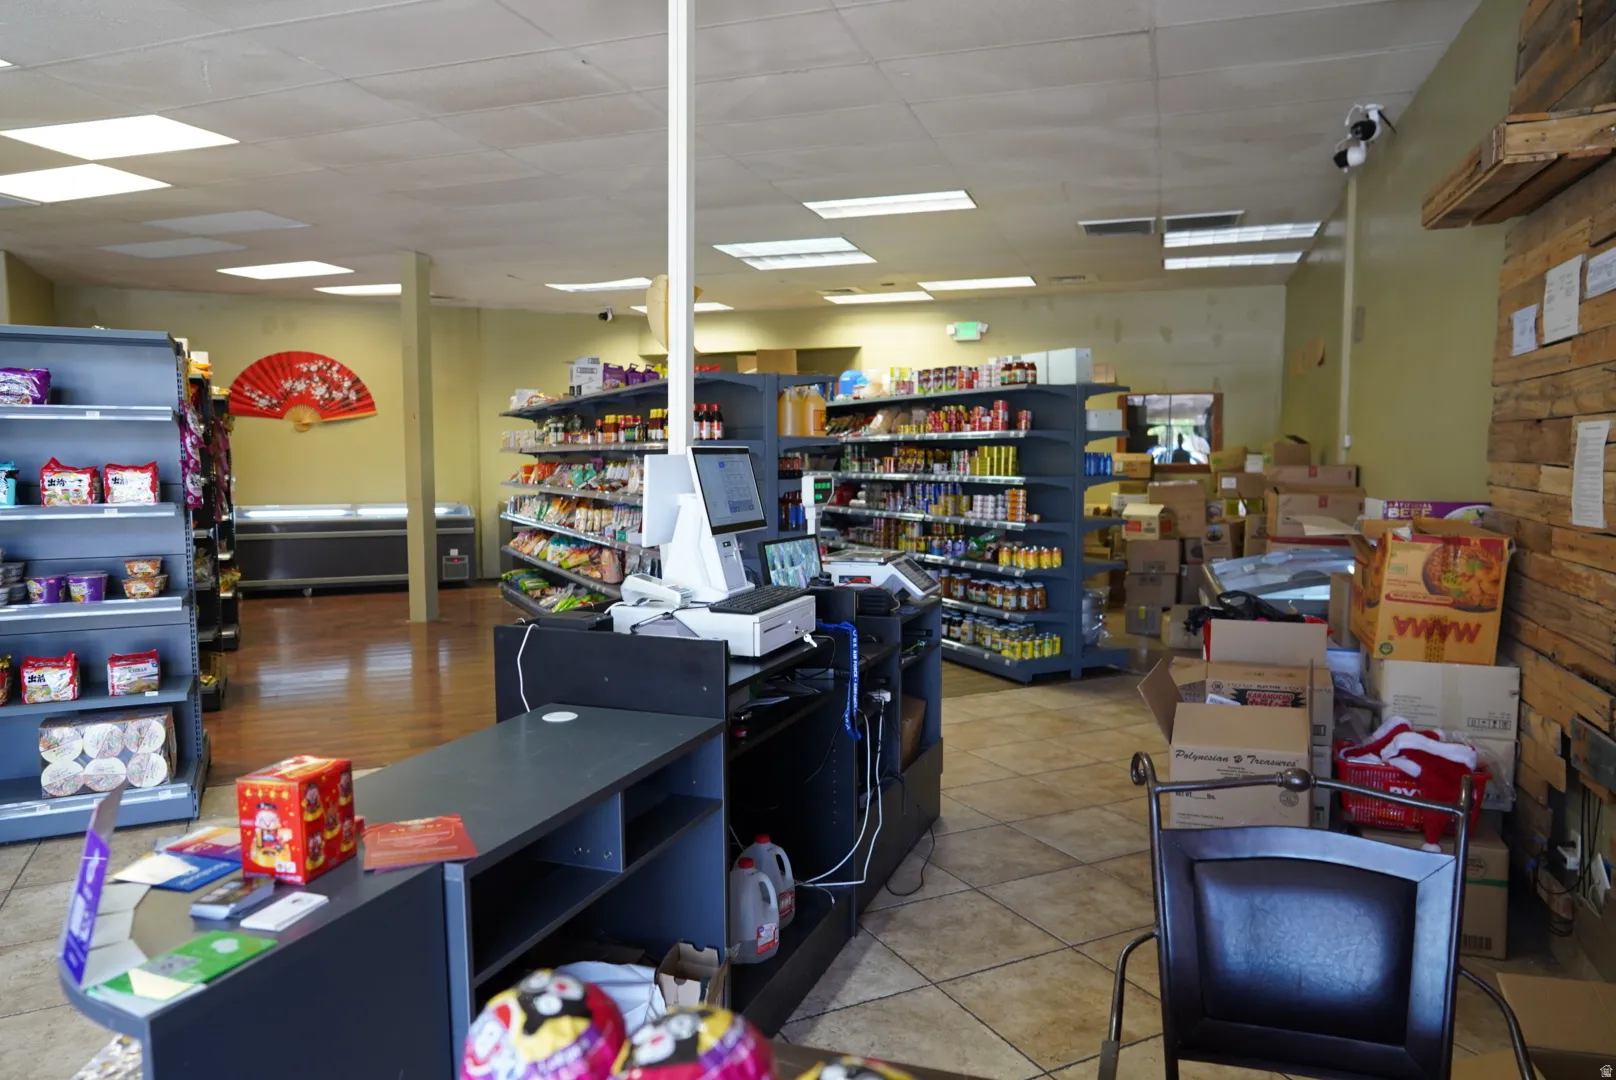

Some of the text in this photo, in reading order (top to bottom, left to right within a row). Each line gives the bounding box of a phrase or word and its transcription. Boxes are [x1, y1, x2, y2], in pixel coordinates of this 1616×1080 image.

[1388, 507, 1432, 518] BEEF
[1393, 616, 1481, 644] MAMA
[1247, 691, 1294, 701] KARAMUCHO
[1175, 749, 1297, 767] Polynesian Treasures
